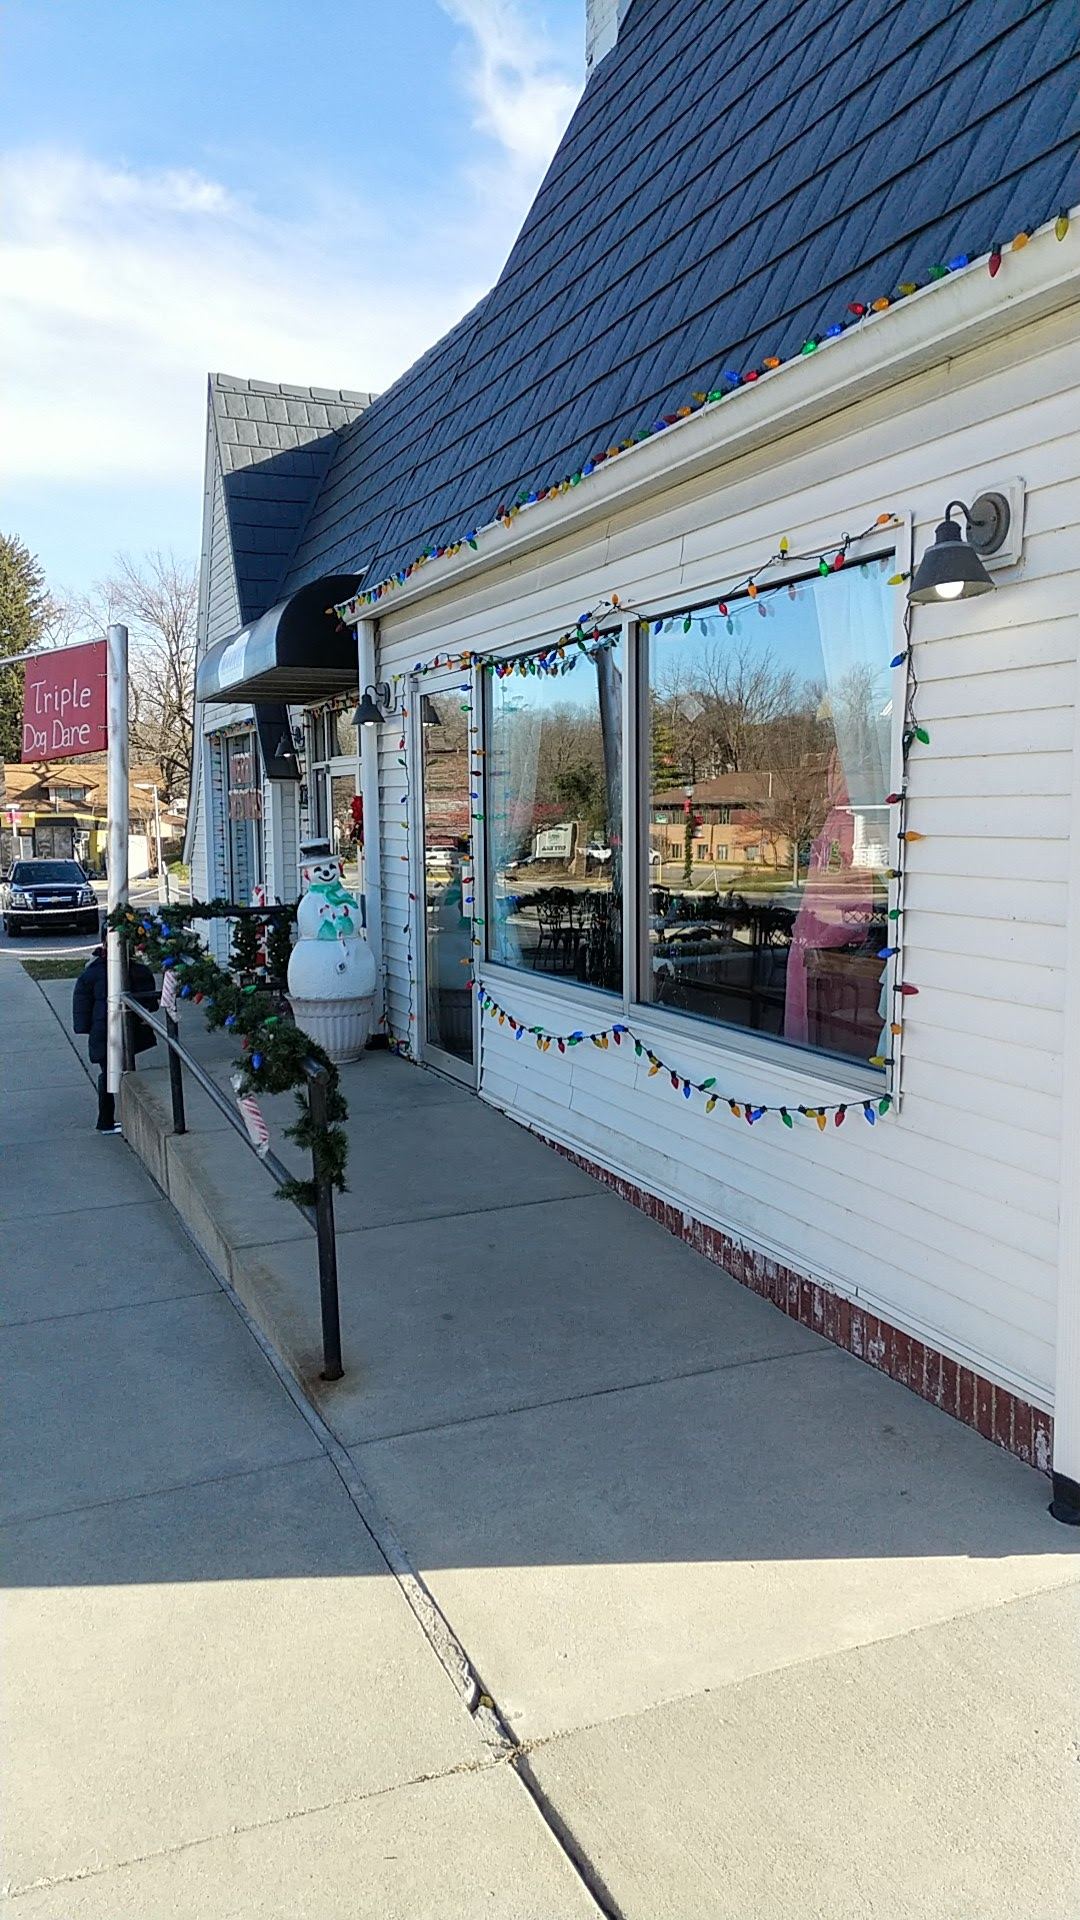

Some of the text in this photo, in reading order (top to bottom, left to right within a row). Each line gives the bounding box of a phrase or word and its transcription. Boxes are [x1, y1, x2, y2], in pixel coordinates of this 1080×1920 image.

[30, 678, 91, 717] Triple
[23, 719, 91, 755] Dog Dare
